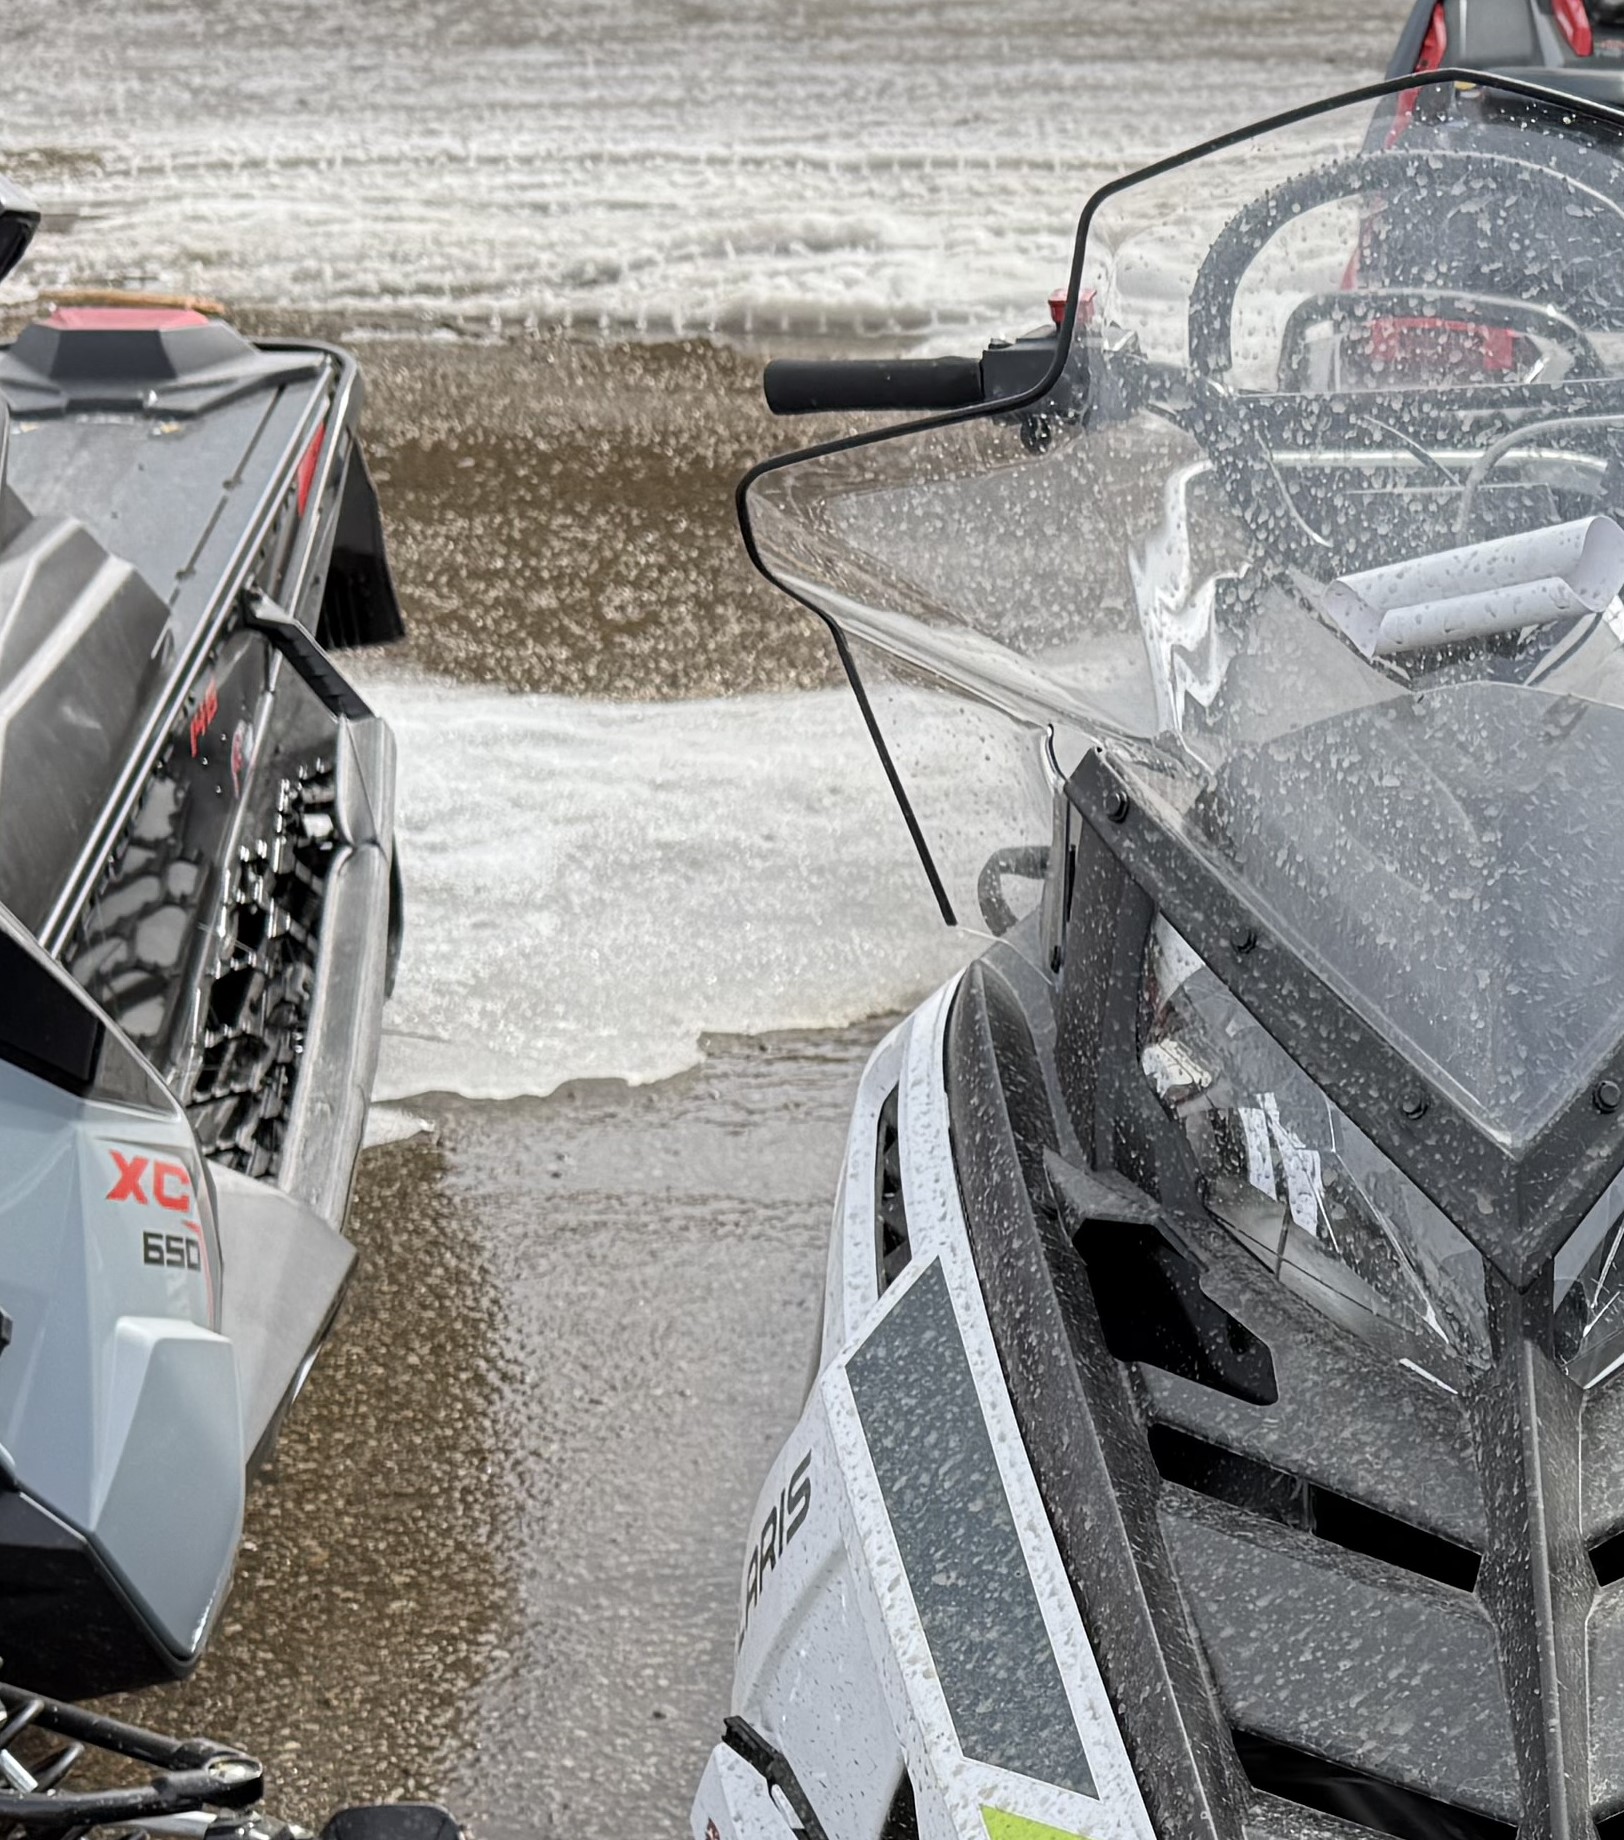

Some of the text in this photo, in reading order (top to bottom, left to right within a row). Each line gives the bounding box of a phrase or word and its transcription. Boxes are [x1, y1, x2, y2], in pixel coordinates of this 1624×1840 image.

[106, 1149, 190, 1214] XC
[143, 1231, 201, 1272] 650
[739, 1448, 812, 1653] ARIS
